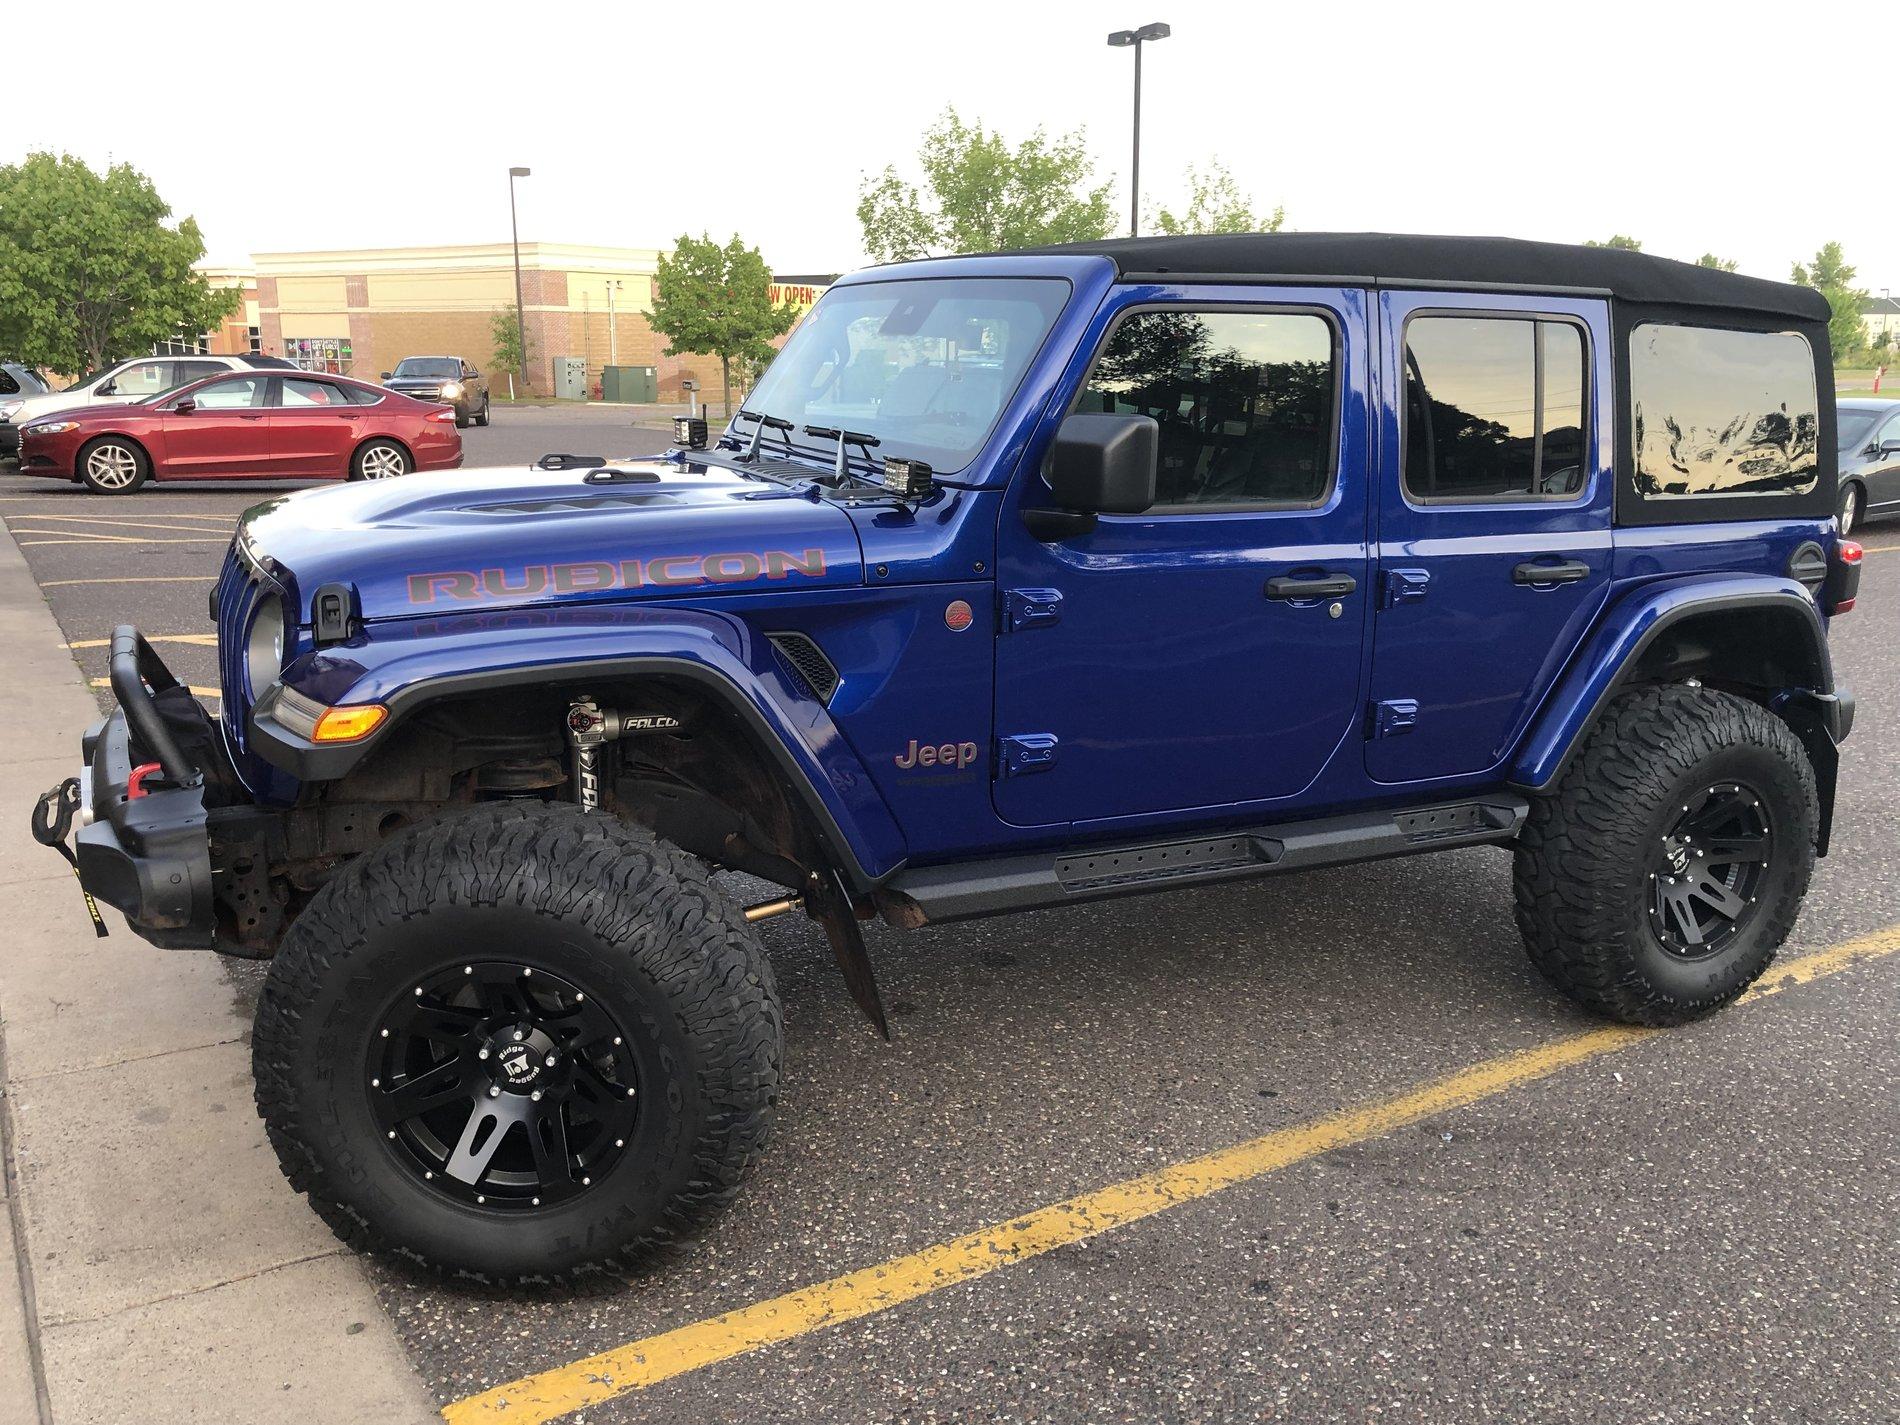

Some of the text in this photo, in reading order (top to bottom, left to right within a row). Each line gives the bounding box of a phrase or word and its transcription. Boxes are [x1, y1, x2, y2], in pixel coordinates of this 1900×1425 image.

[784, 286, 812, 305] OPEN
[407, 548, 827, 605] RUBICON
[895, 739, 978, 769] Jeep
[498, 1046, 524, 1060] Ridge
